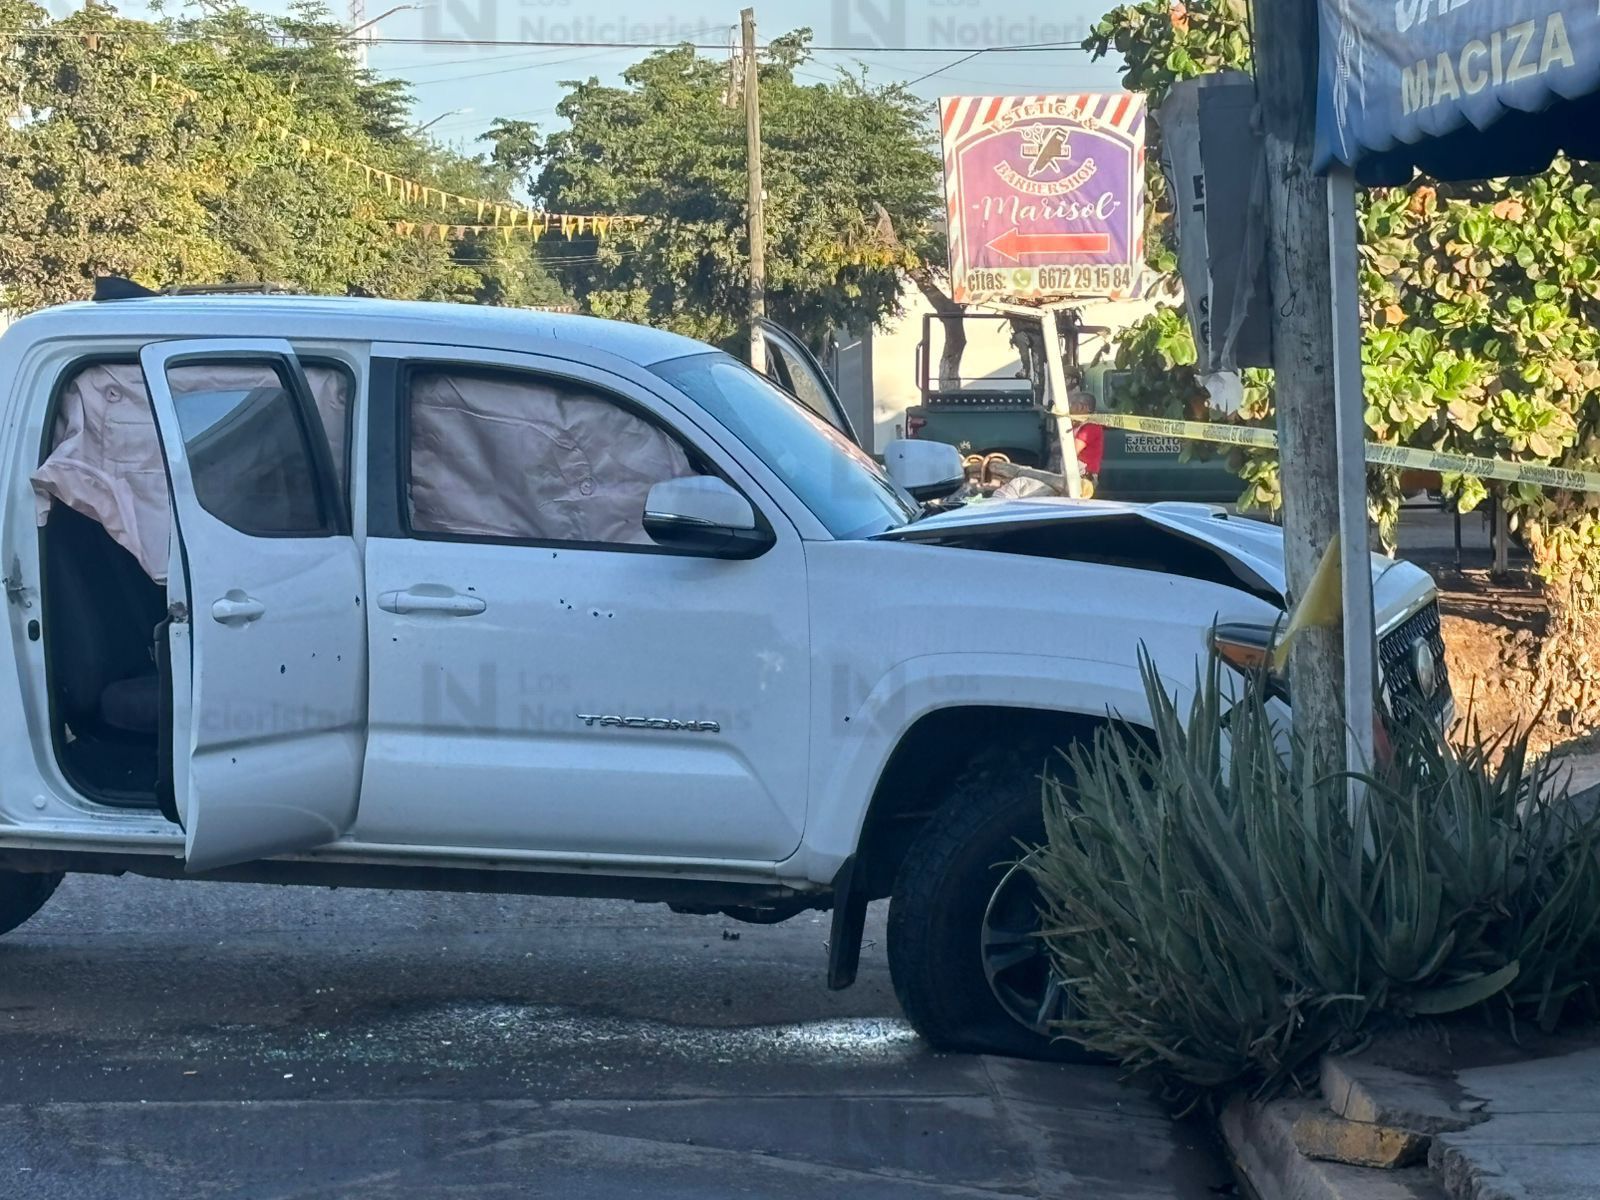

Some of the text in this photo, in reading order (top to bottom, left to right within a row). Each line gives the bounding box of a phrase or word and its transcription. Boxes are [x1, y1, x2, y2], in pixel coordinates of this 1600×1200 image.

[1400, 12, 1575, 116] MACIZA
[990, 102, 1081, 133] ESTETICA
[995, 160, 1096, 194] BARBERSHOP
[967, 266, 1131, 291] citas: 6672 29 15 84
[1126, 444, 1180, 453] MEXICANO
[576, 713, 721, 733] TACOMA
